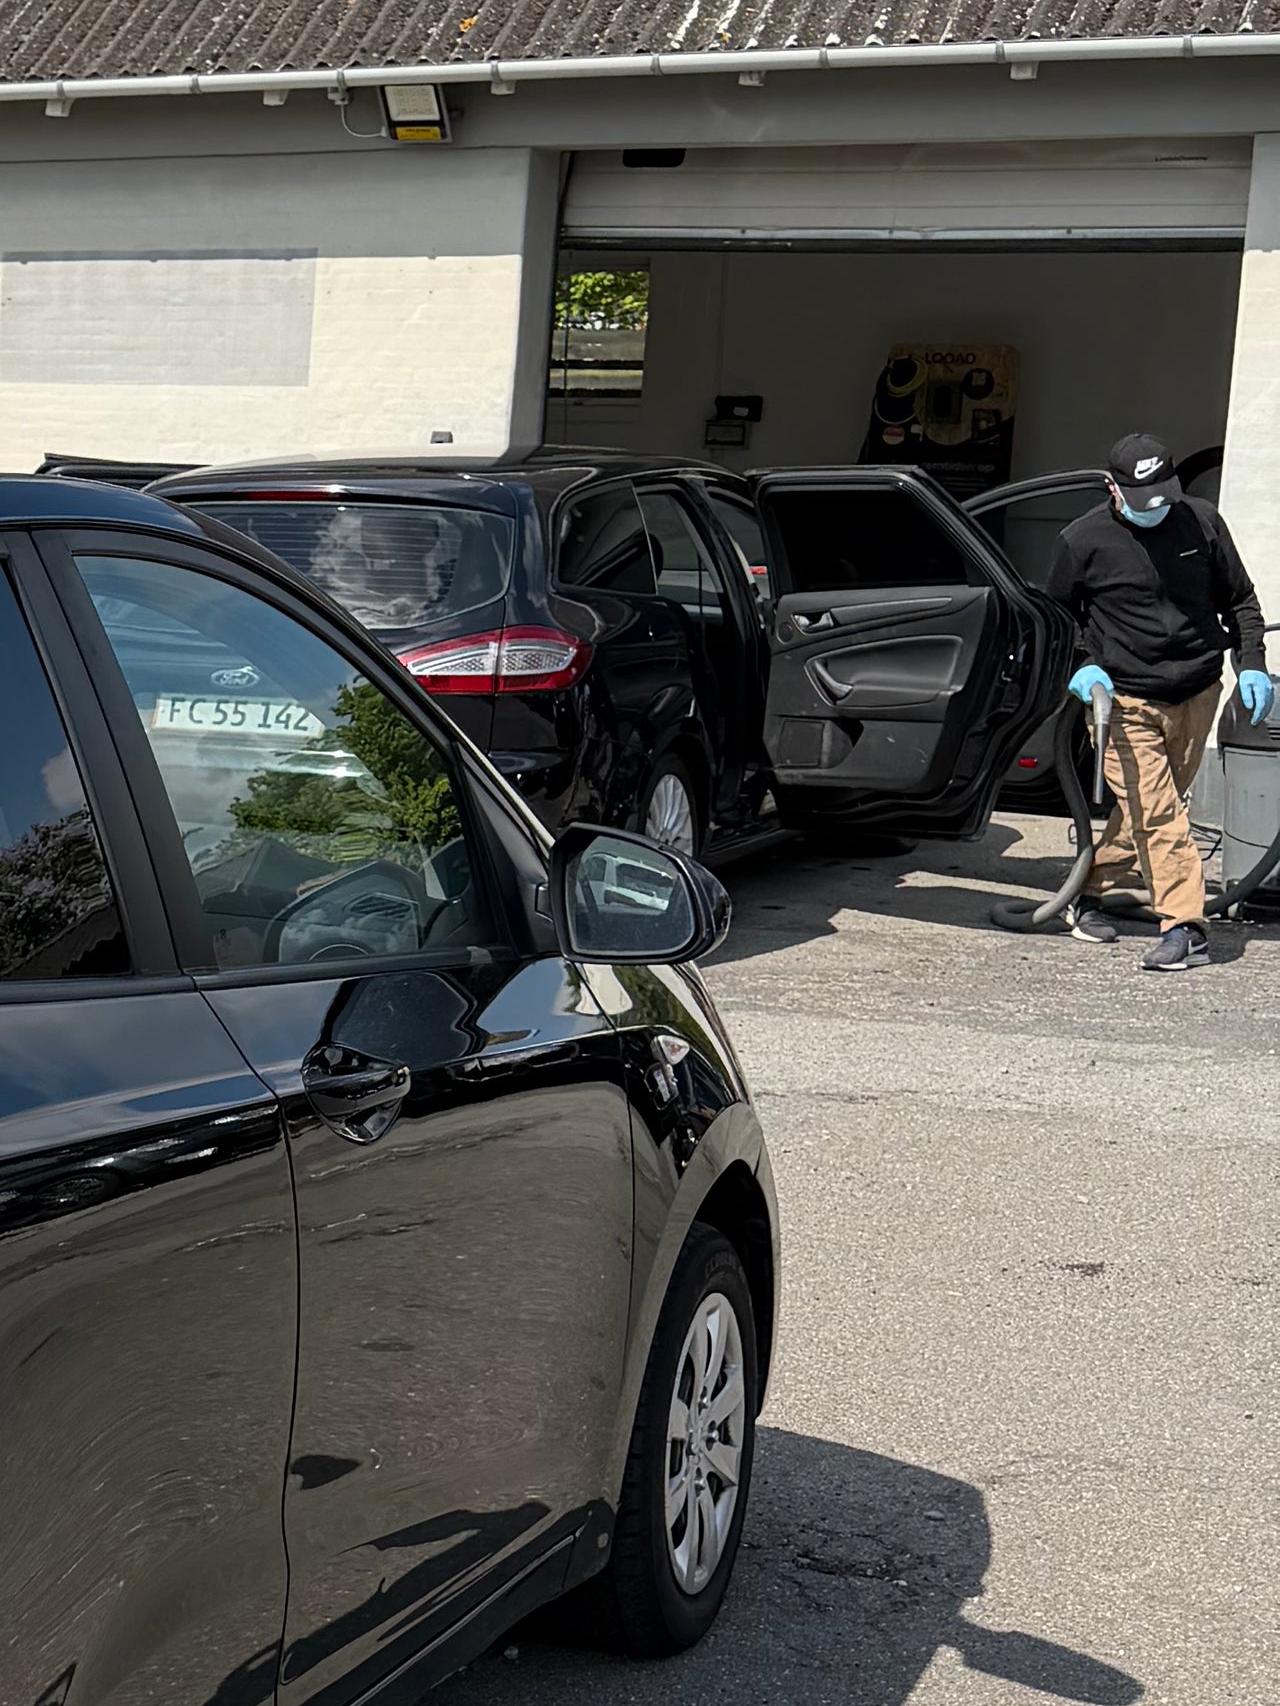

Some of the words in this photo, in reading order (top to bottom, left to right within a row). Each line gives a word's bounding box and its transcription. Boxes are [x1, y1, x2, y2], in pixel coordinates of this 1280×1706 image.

[169, 697, 207, 724] FC
[212, 698, 248, 727] 55
[257, 702, 310, 731] 142
